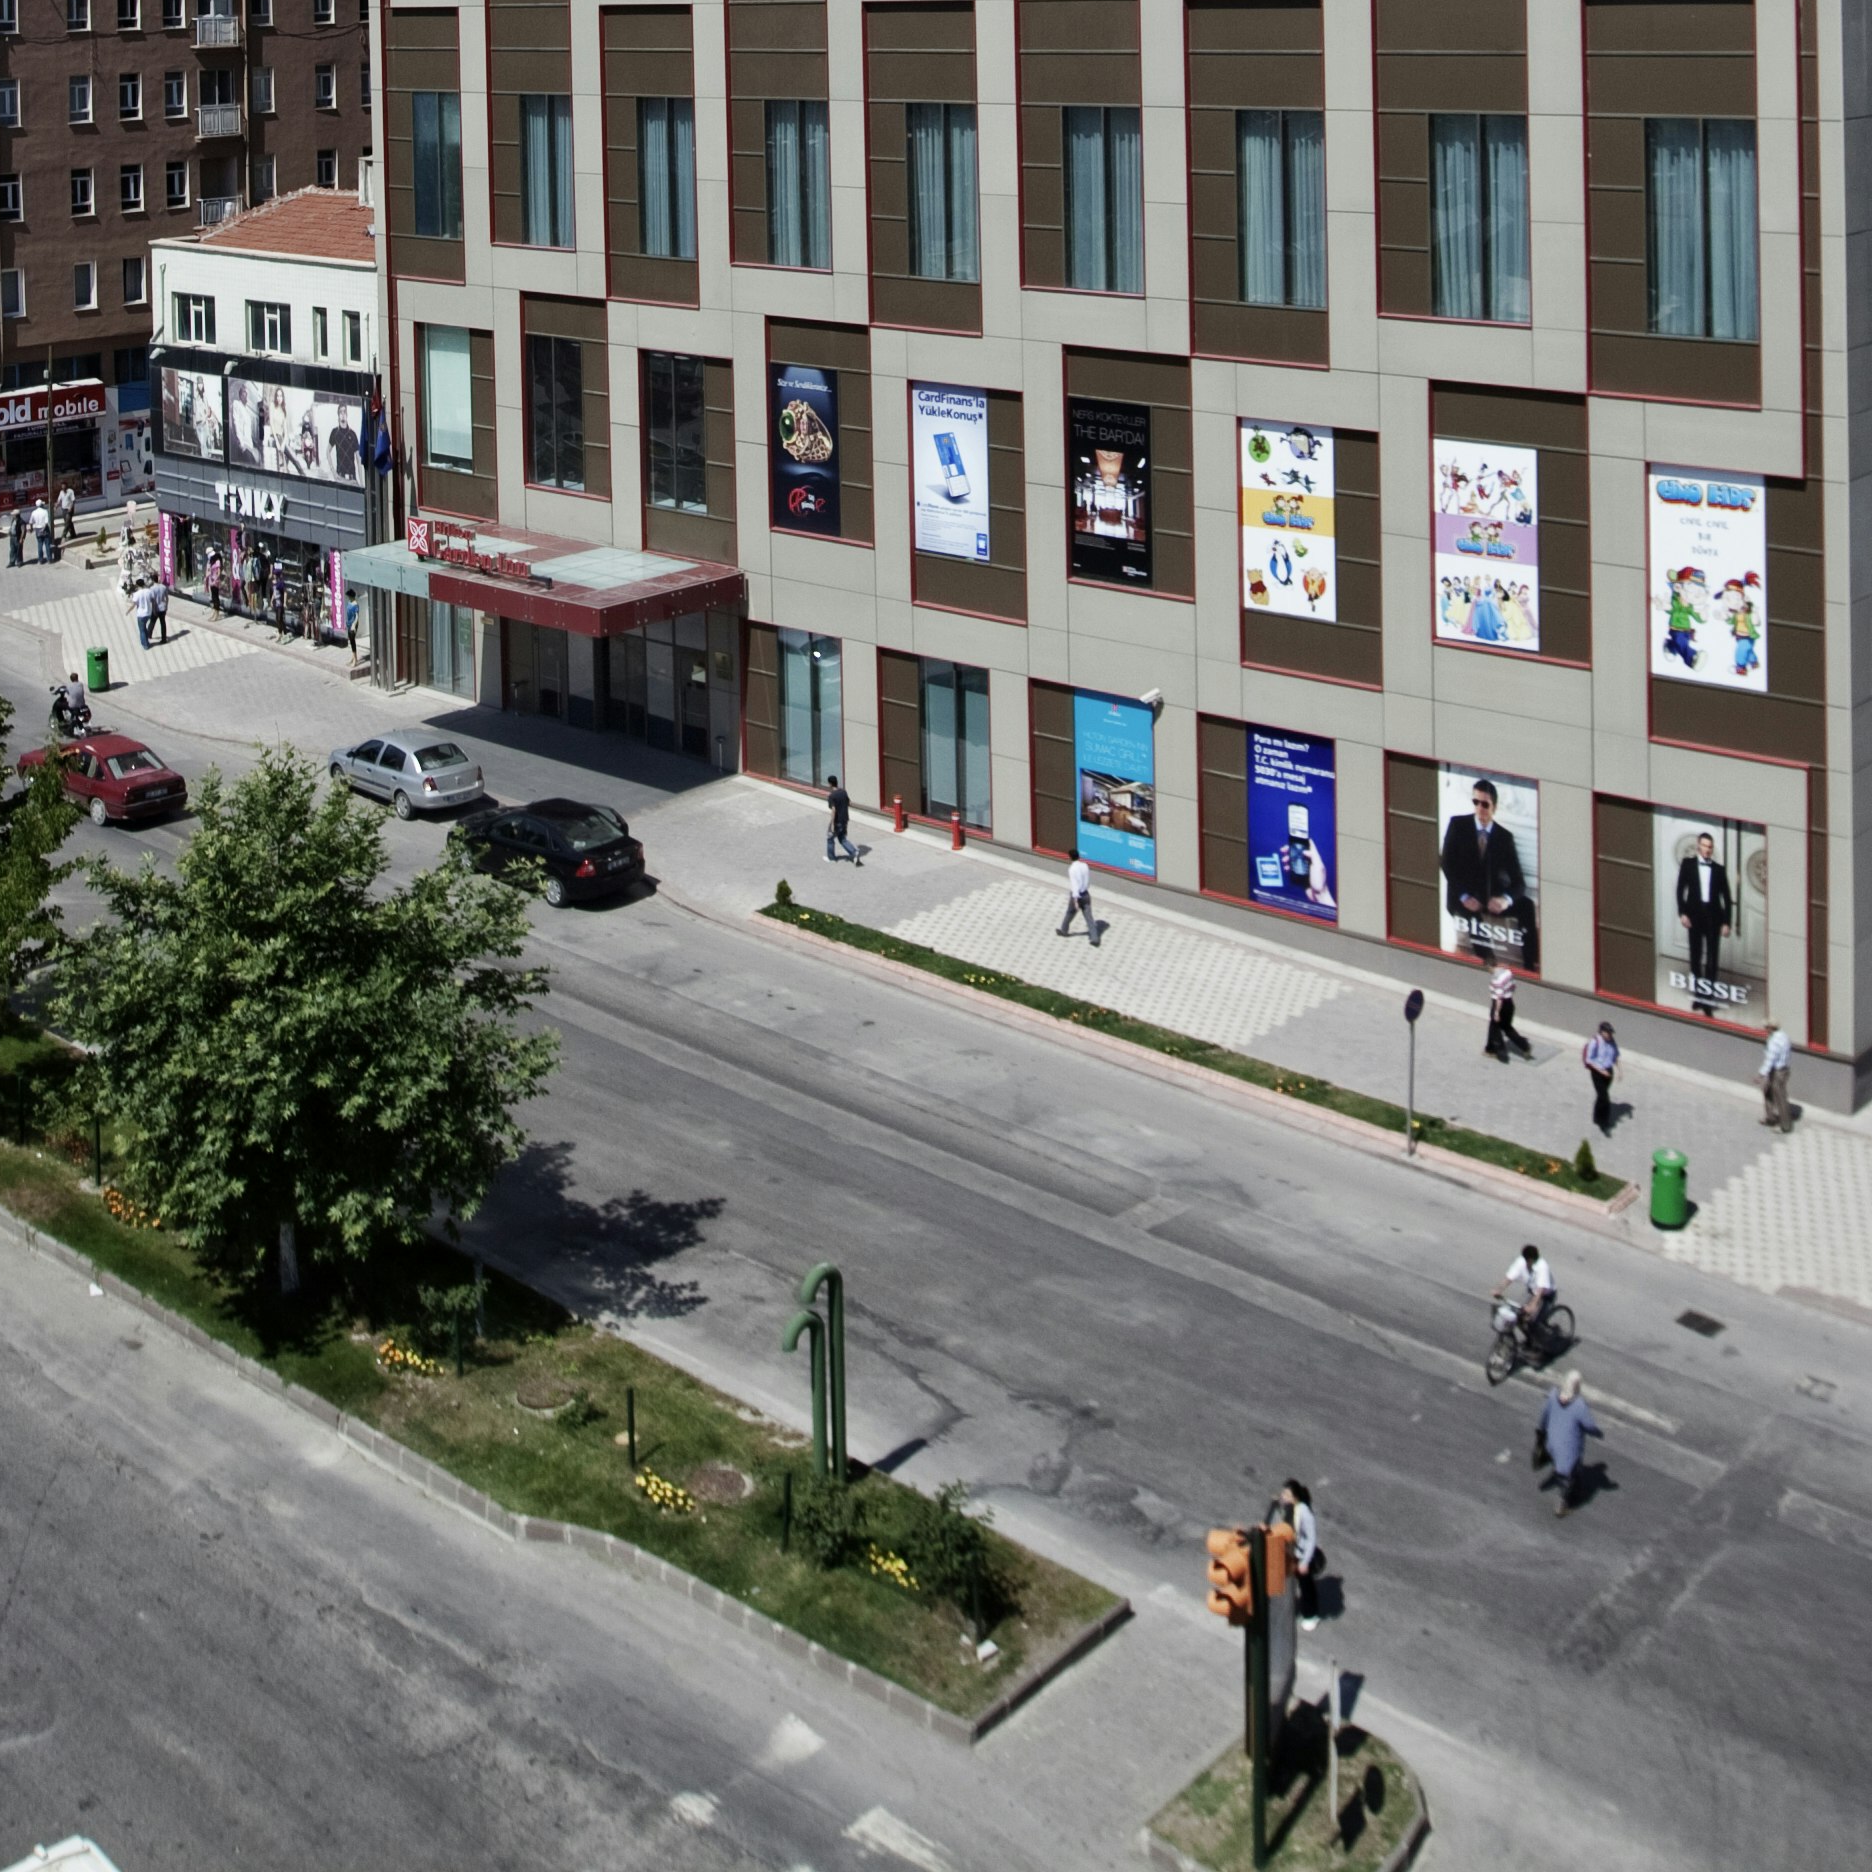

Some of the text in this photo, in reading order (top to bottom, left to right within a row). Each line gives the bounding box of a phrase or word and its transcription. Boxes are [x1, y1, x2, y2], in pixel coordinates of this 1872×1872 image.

[917, 390, 985, 408] CardFinans'la
[37, 396, 99, 420] mobile
[1074, 424, 1096, 440] THE
[1254, 734, 1271, 746] Para
[1254, 745, 1288, 759] O zaman
[1283, 773, 1306, 785] mesaj
